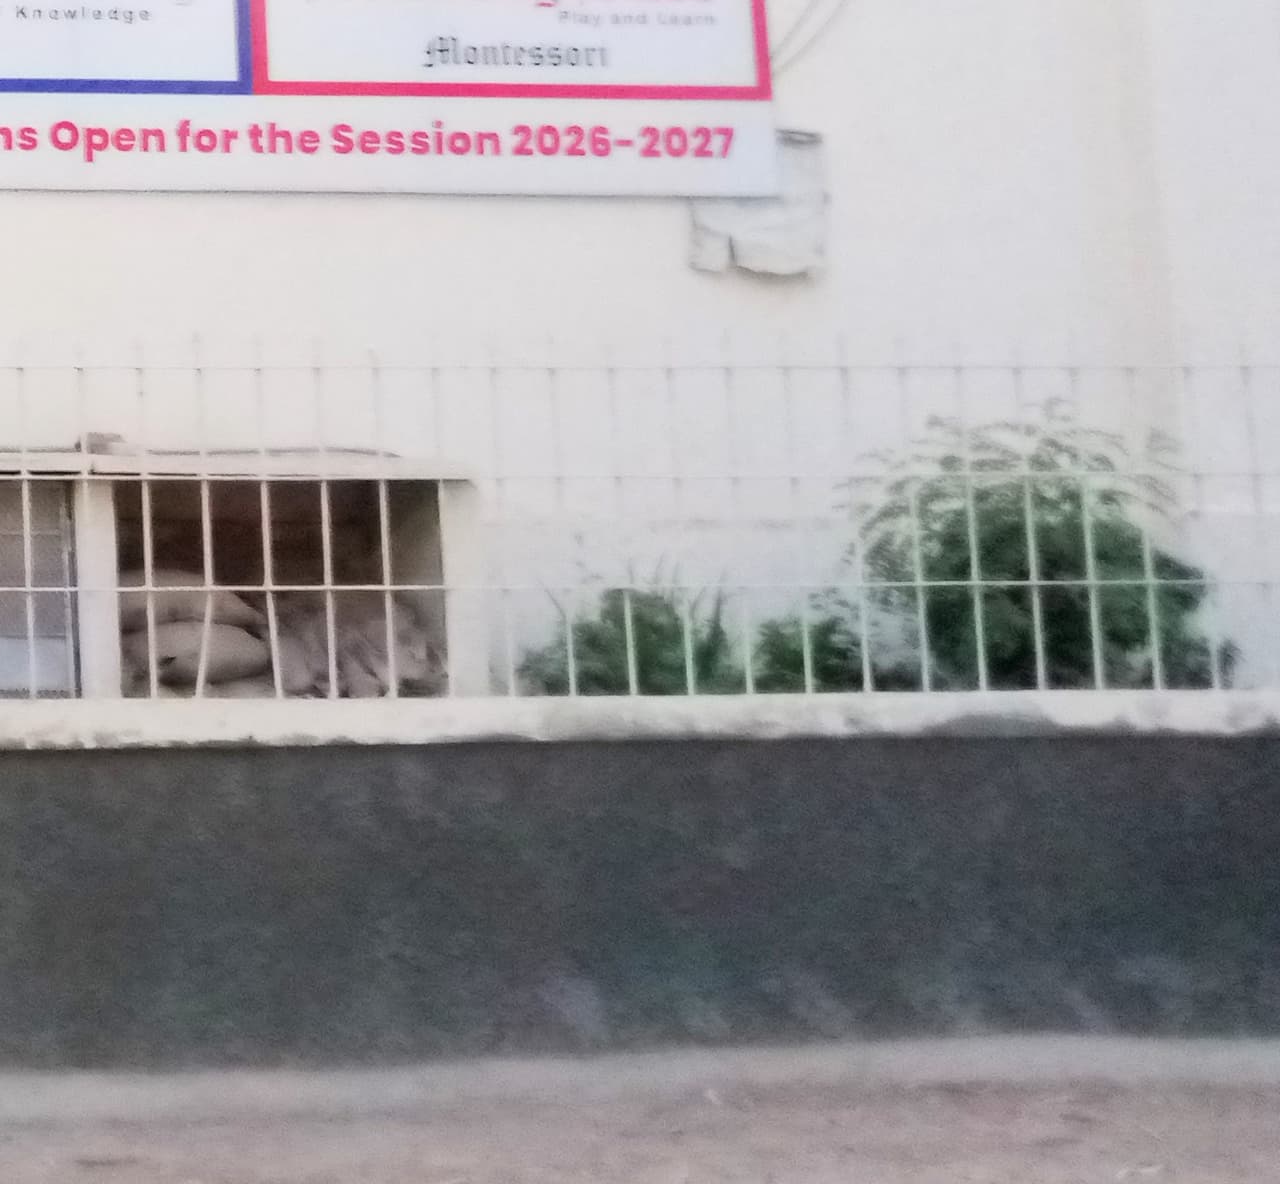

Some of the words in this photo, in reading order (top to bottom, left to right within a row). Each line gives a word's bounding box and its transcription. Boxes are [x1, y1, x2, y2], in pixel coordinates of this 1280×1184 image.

[15, 5, 152, 24] Knowledge
[422, 36, 610, 68] Montessori
[50, 120, 167, 163] Open
[178, 120, 240, 153] for
[248, 122, 322, 154] the
[331, 120, 504, 156] Session
